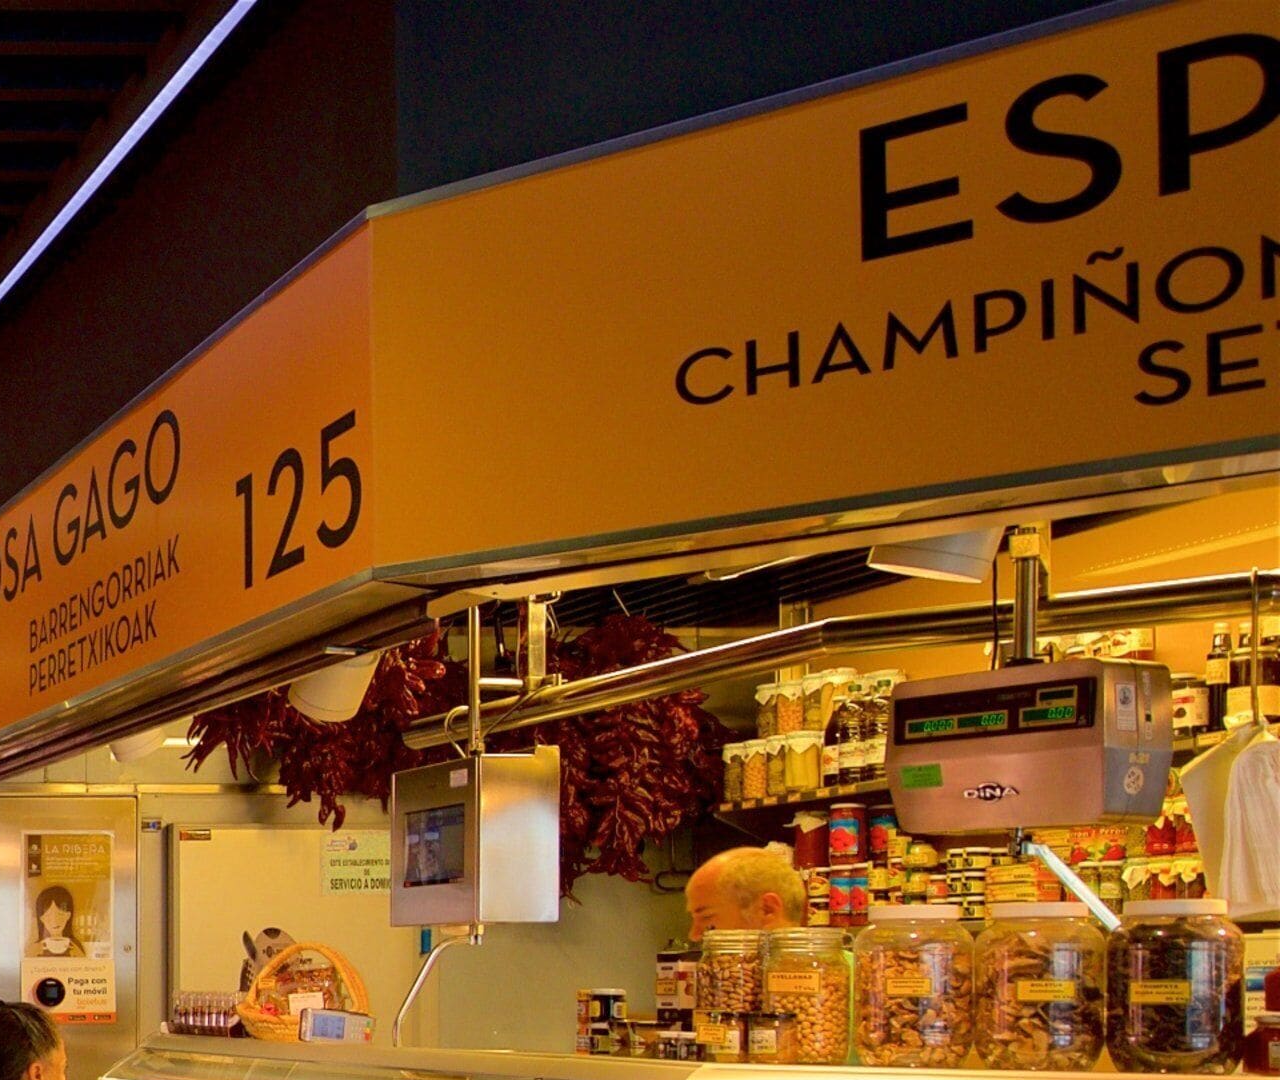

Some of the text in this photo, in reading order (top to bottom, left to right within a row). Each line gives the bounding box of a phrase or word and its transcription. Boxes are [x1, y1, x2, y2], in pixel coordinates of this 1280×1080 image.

[1134, 320, 1280, 406] SE
[53, 409, 181, 566] GAGO
[236, 409, 362, 590] 125
[29, 534, 180, 653] BARRENGORRIAK
[28, 600, 158, 696] PERRETXIKOAK
[44, 843, 105, 854] LA RIBERA
[330, 878, 362, 890] SERVICIO
[363, 879, 369, 889] A
[67, 977, 90, 986] Paga
[73, 986, 108, 996] tu móvil
